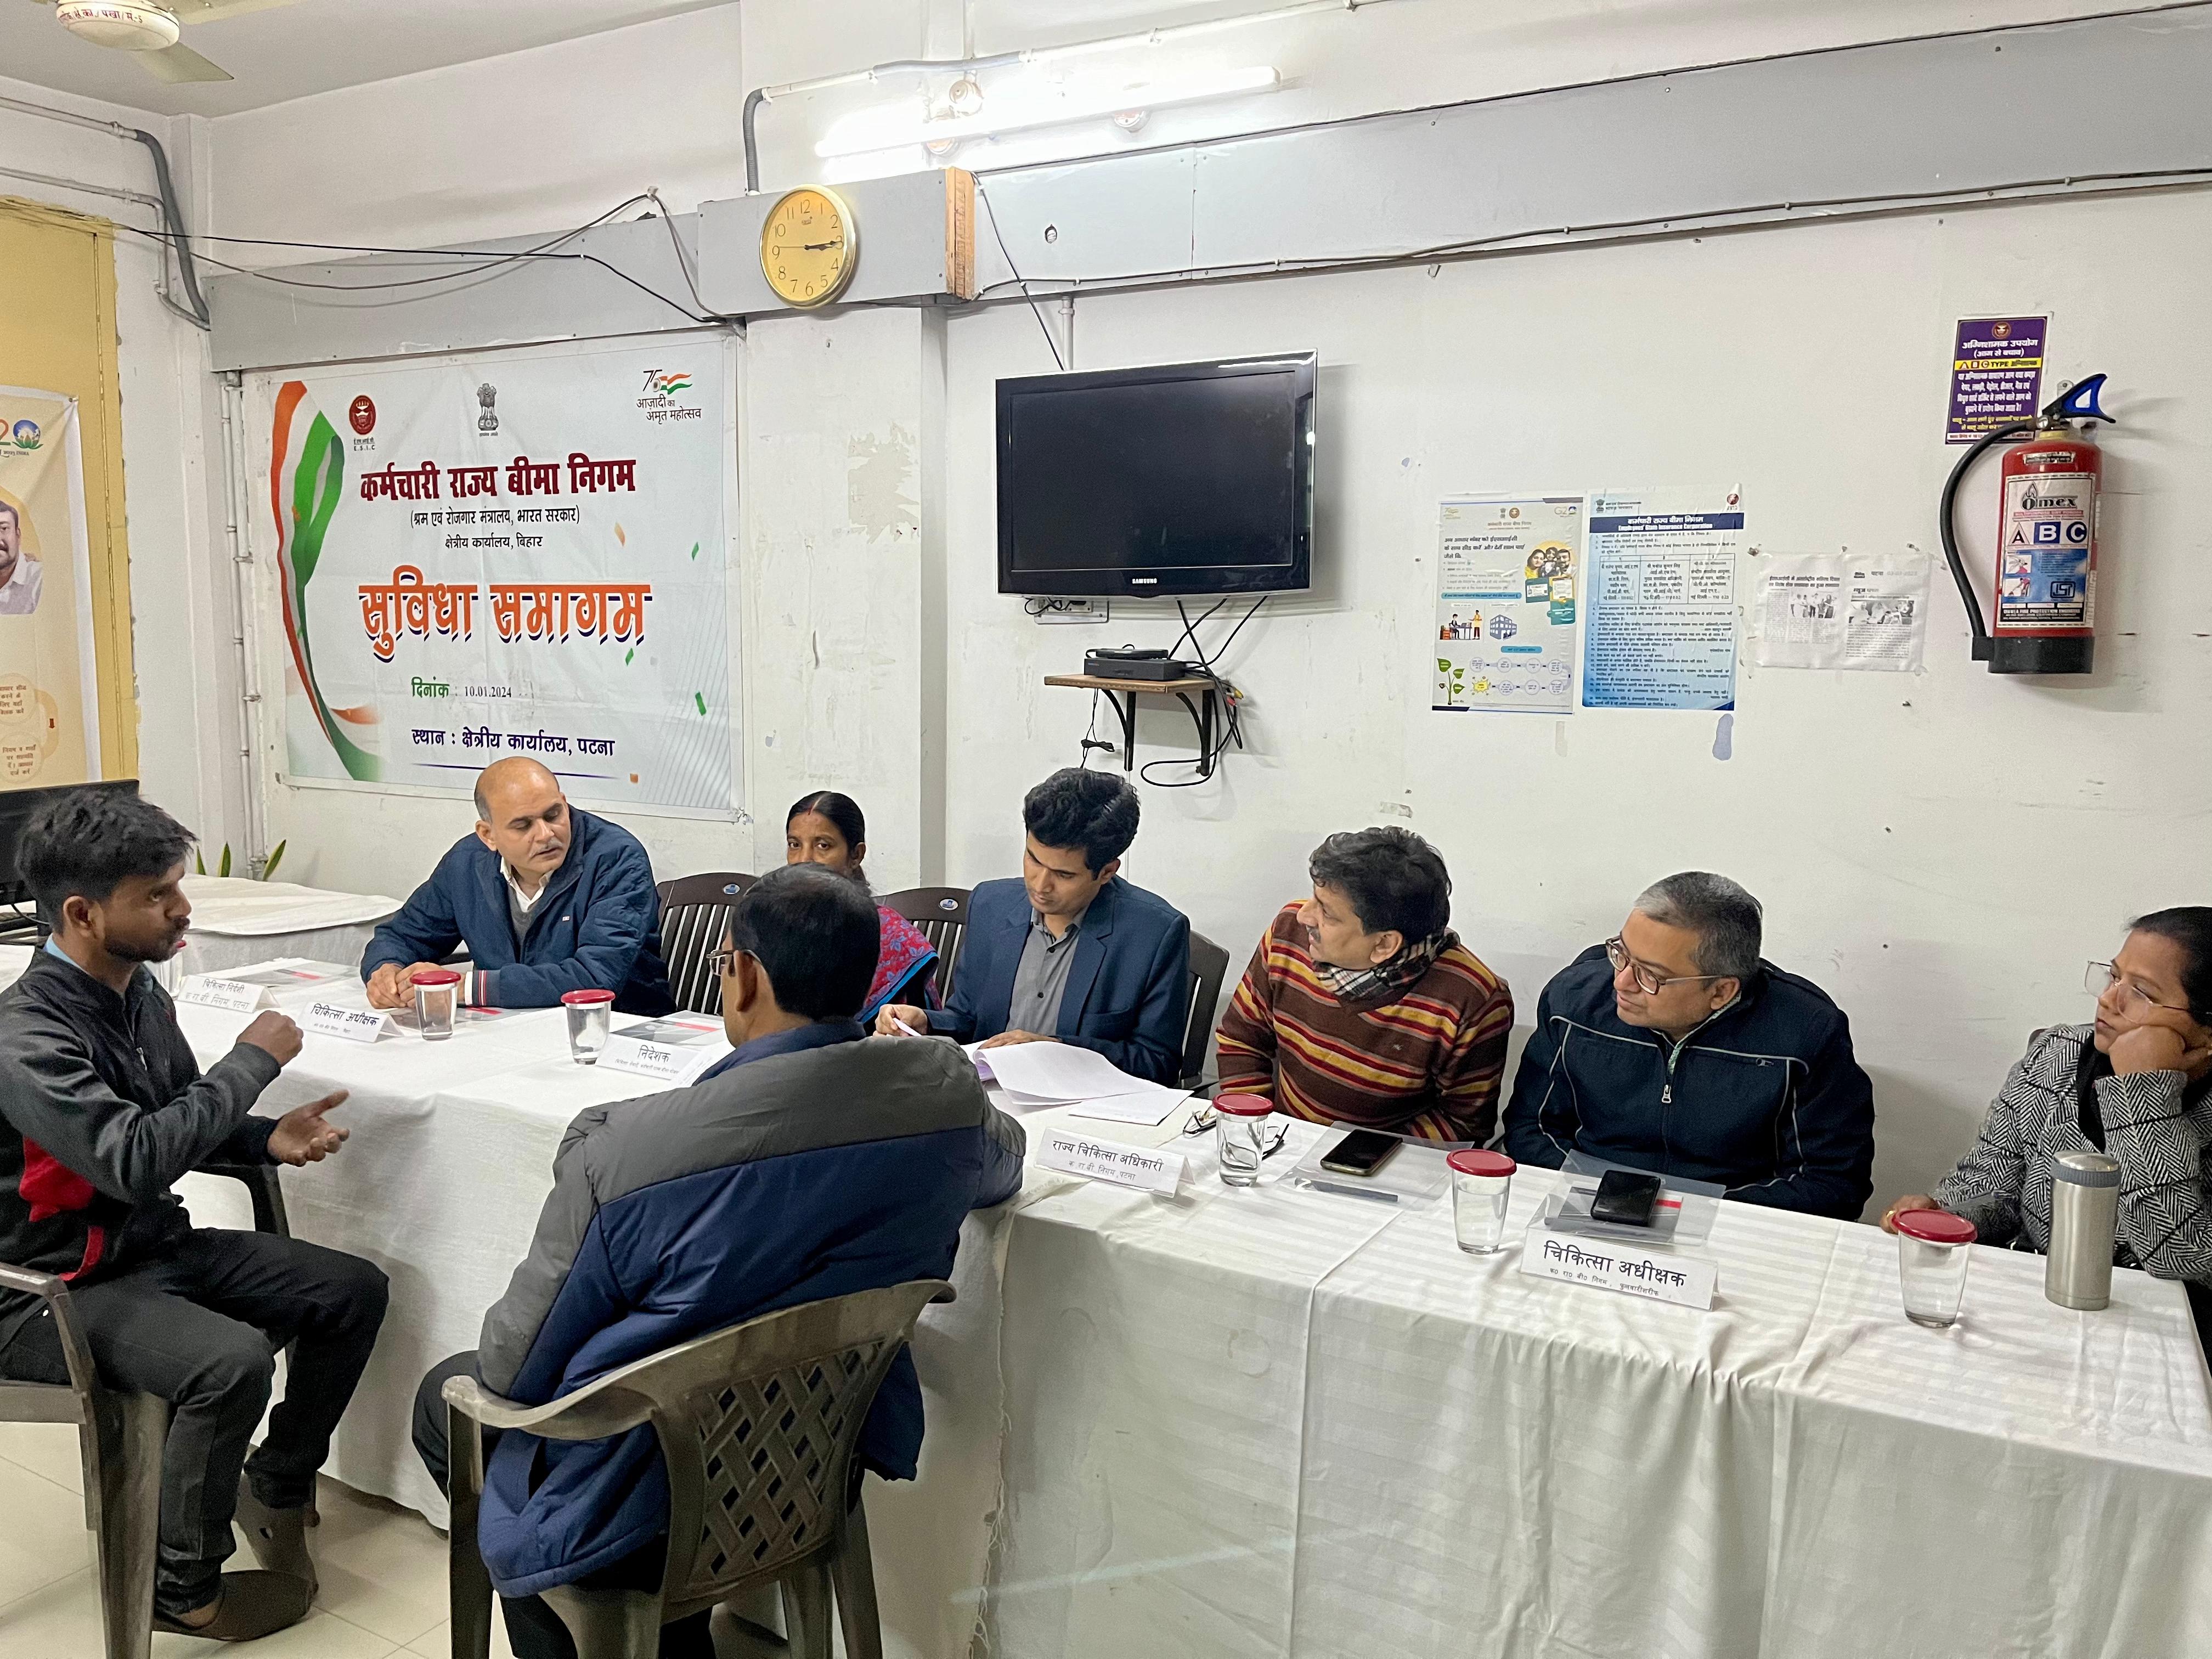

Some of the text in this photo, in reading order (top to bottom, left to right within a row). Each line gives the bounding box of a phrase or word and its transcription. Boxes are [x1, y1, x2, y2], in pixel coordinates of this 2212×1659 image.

[787, 206, 794, 220] 11
[800, 199, 811, 214] 12
[775, 223, 786, 238] 10
[831, 215, 838, 229] 2
[772, 245, 780, 259] 9
[778, 266, 786, 280] 8
[831, 258, 839, 271] 4
[790, 279, 798, 292] 7
[805, 281, 814, 296] 6
[820, 275, 828, 287] 5
[2010, 337, 2039, 348] उपयोग
[636, 393, 666, 410] आज़ादी
[646, 405, 702, 425] अमृत महोत्सव
[360, 453, 636, 501] कर्मचारी राज्य बीमा निगम
[411, 504, 580, 529] (श्रम एवं रोजगार मंत्रालय, भारत सरकार)
[445, 532, 543, 550] क्षेत्रीय कार्यालय, बिहार
[2012, 523, 2085, 544] A B C
[358, 565, 653, 663] सुविधा समागम
[411, 676, 450, 698] दिनांक
[464, 685, 512, 698] 10.01.2024
[411, 729, 446, 746] स्थान
[462, 725, 503, 749] क्षेत्रीय
[506, 729, 573, 757] कार्यालय,
[577, 737, 616, 757] पटना
[310, 1003, 346, 1021] चिकित्सा
[637, 1044, 672, 1063] निदेशक
[1052, 1140, 1164, 1172] राज्य चिकित्सा अधिकारी
[1543, 1240, 1687, 1288] चिकित्सा अधीक्षक
